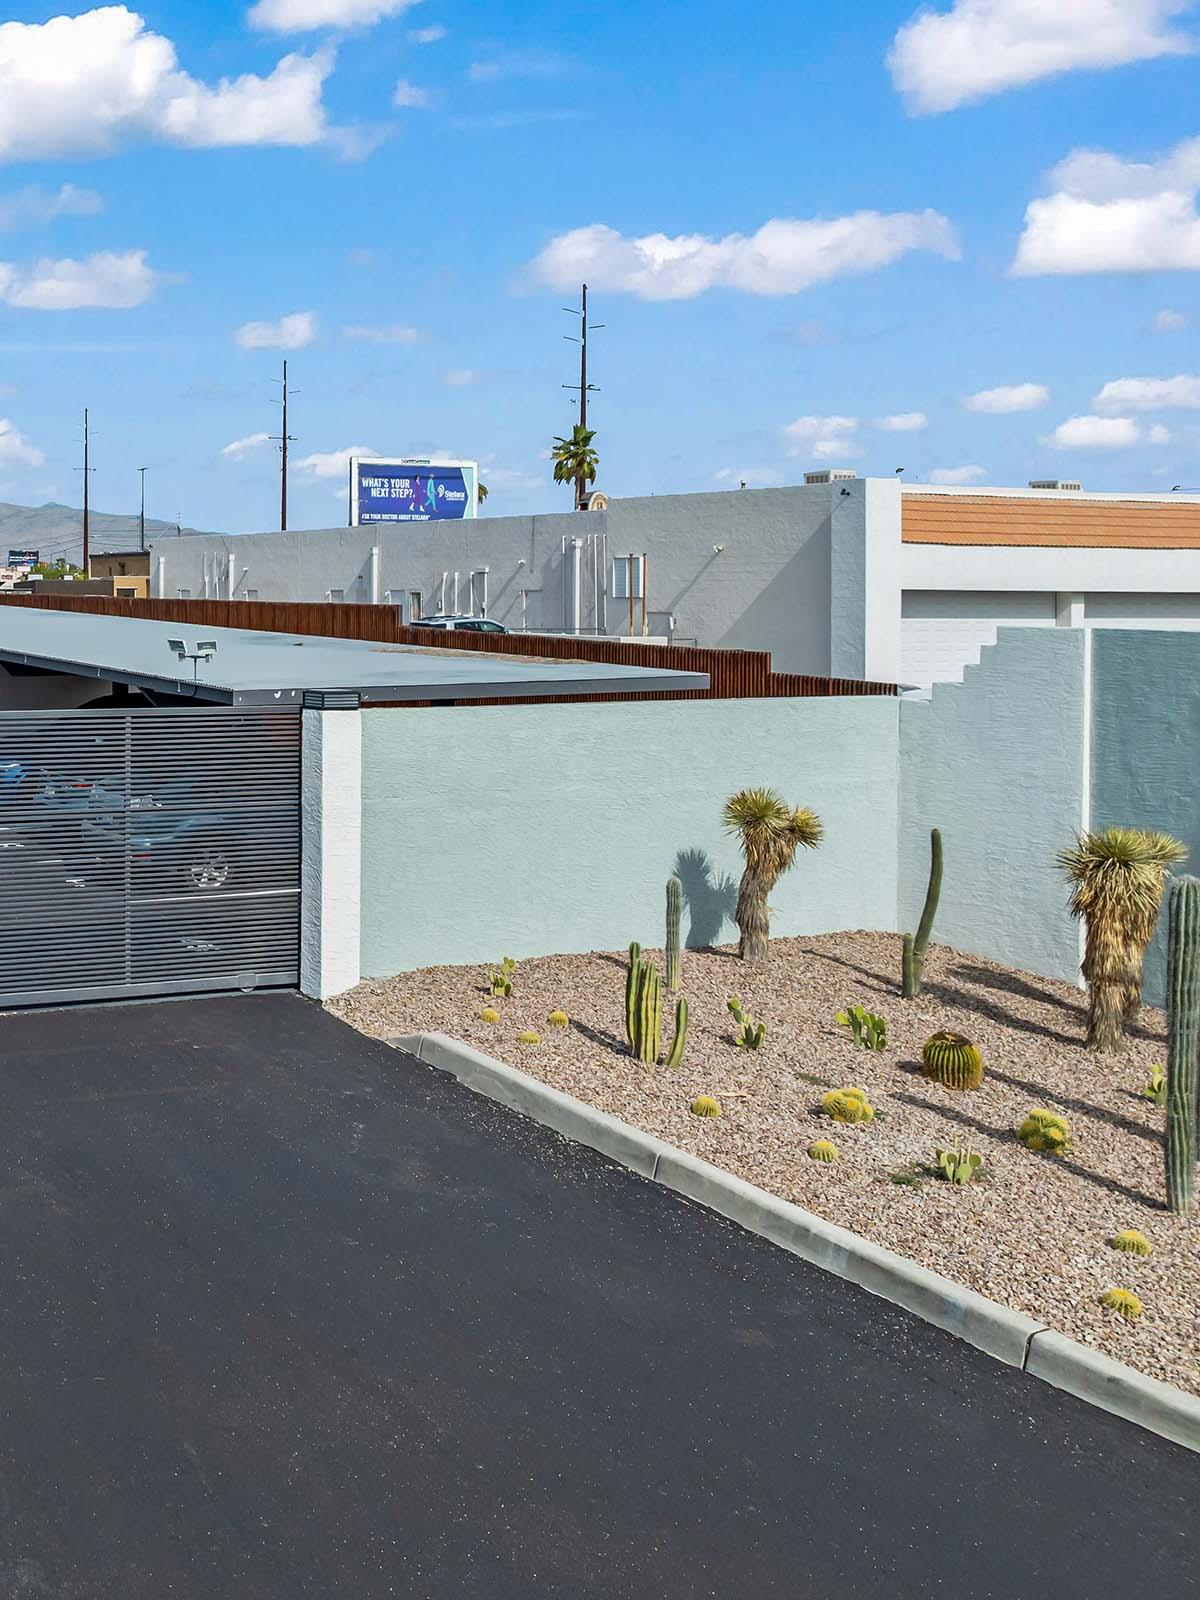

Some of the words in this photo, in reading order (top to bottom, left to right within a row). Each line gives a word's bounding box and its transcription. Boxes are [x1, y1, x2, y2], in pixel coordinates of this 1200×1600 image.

[362, 478, 389, 487] WHAT'S
[390, 479, 410, 488] YOUR
[371, 488, 389, 497] NEXT
[391, 489, 413, 498] STEP?
